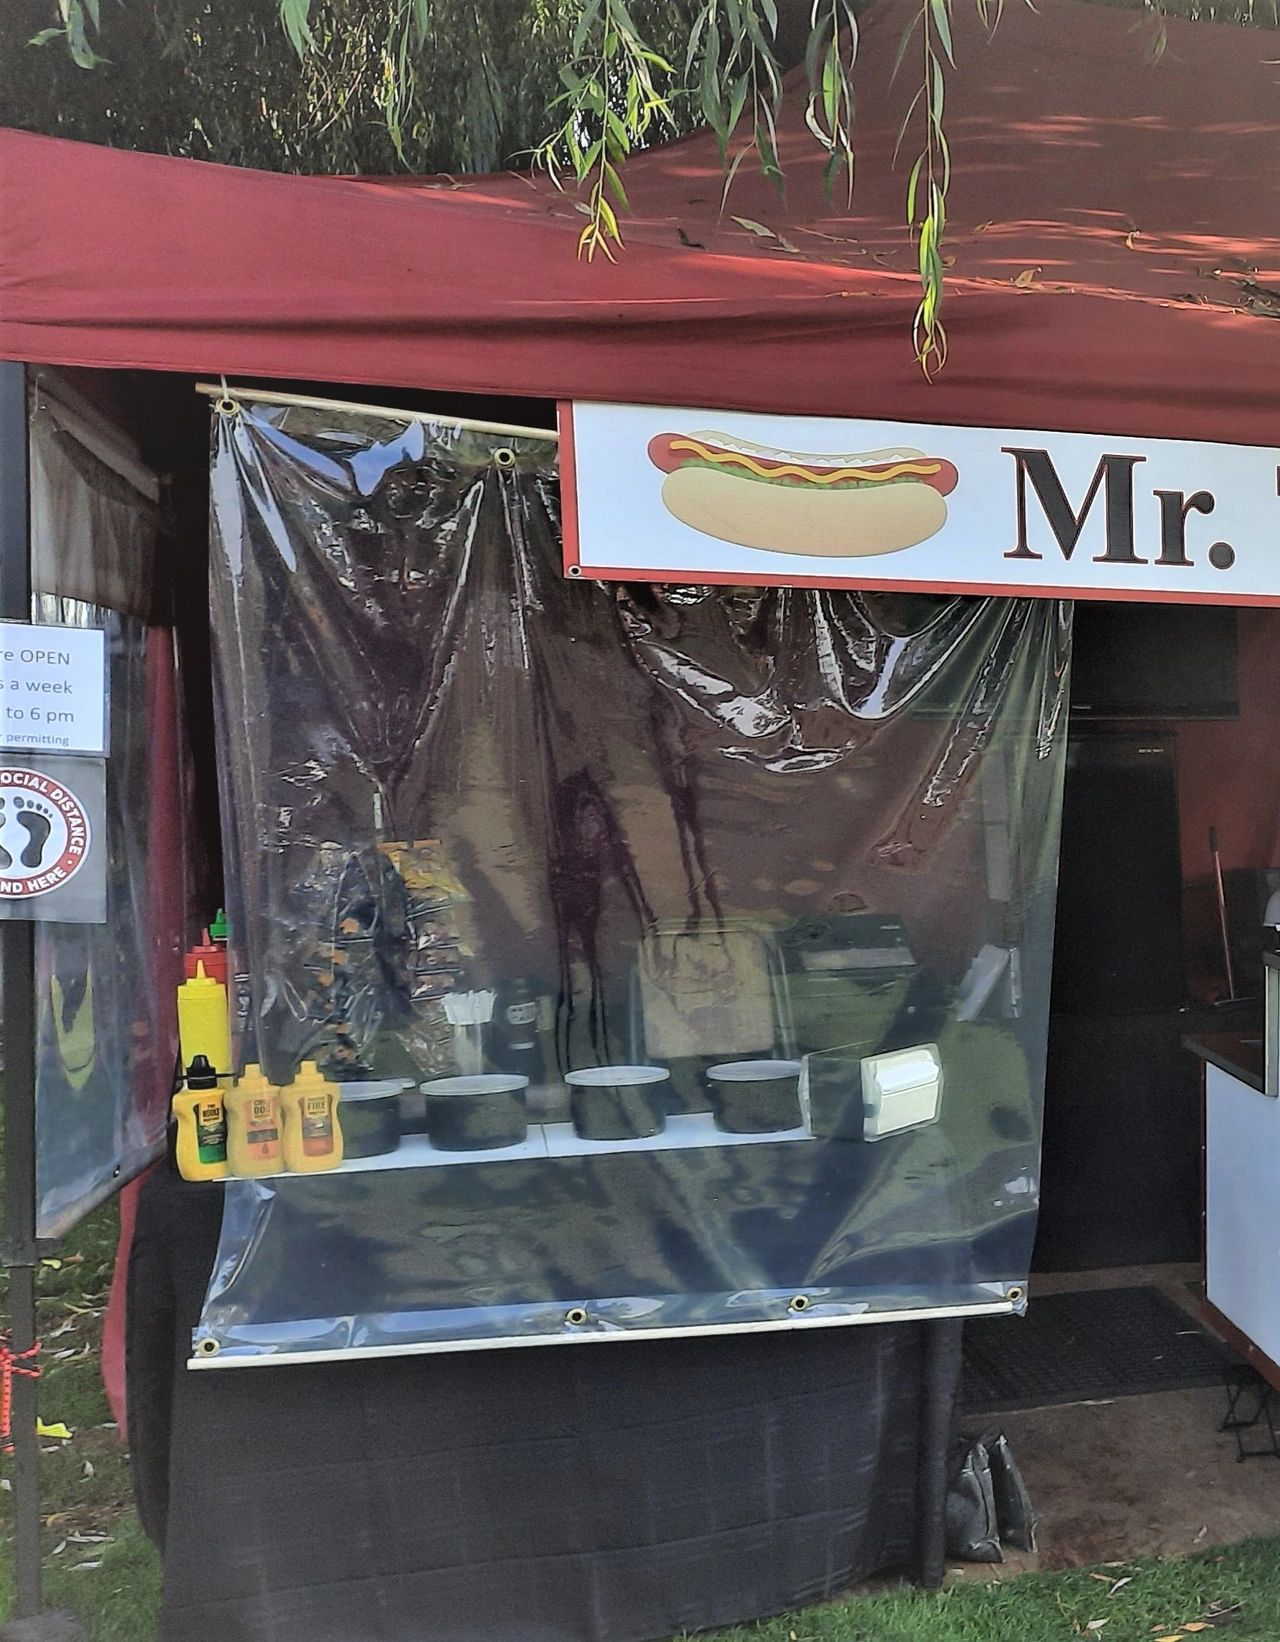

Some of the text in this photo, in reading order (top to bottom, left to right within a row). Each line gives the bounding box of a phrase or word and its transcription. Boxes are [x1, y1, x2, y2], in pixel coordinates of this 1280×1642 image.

[1001, 446, 1236, 570] Mr.
[20, 649, 70, 666] OPEN
[10, 681, 19, 691] a
[26, 678, 73, 694] week
[6, 706, 75, 724] to 6 pm
[6, 731, 70, 747] permitting
[50, 788, 85, 855] DISTANCE
[26, 865, 67, 892] HERE
